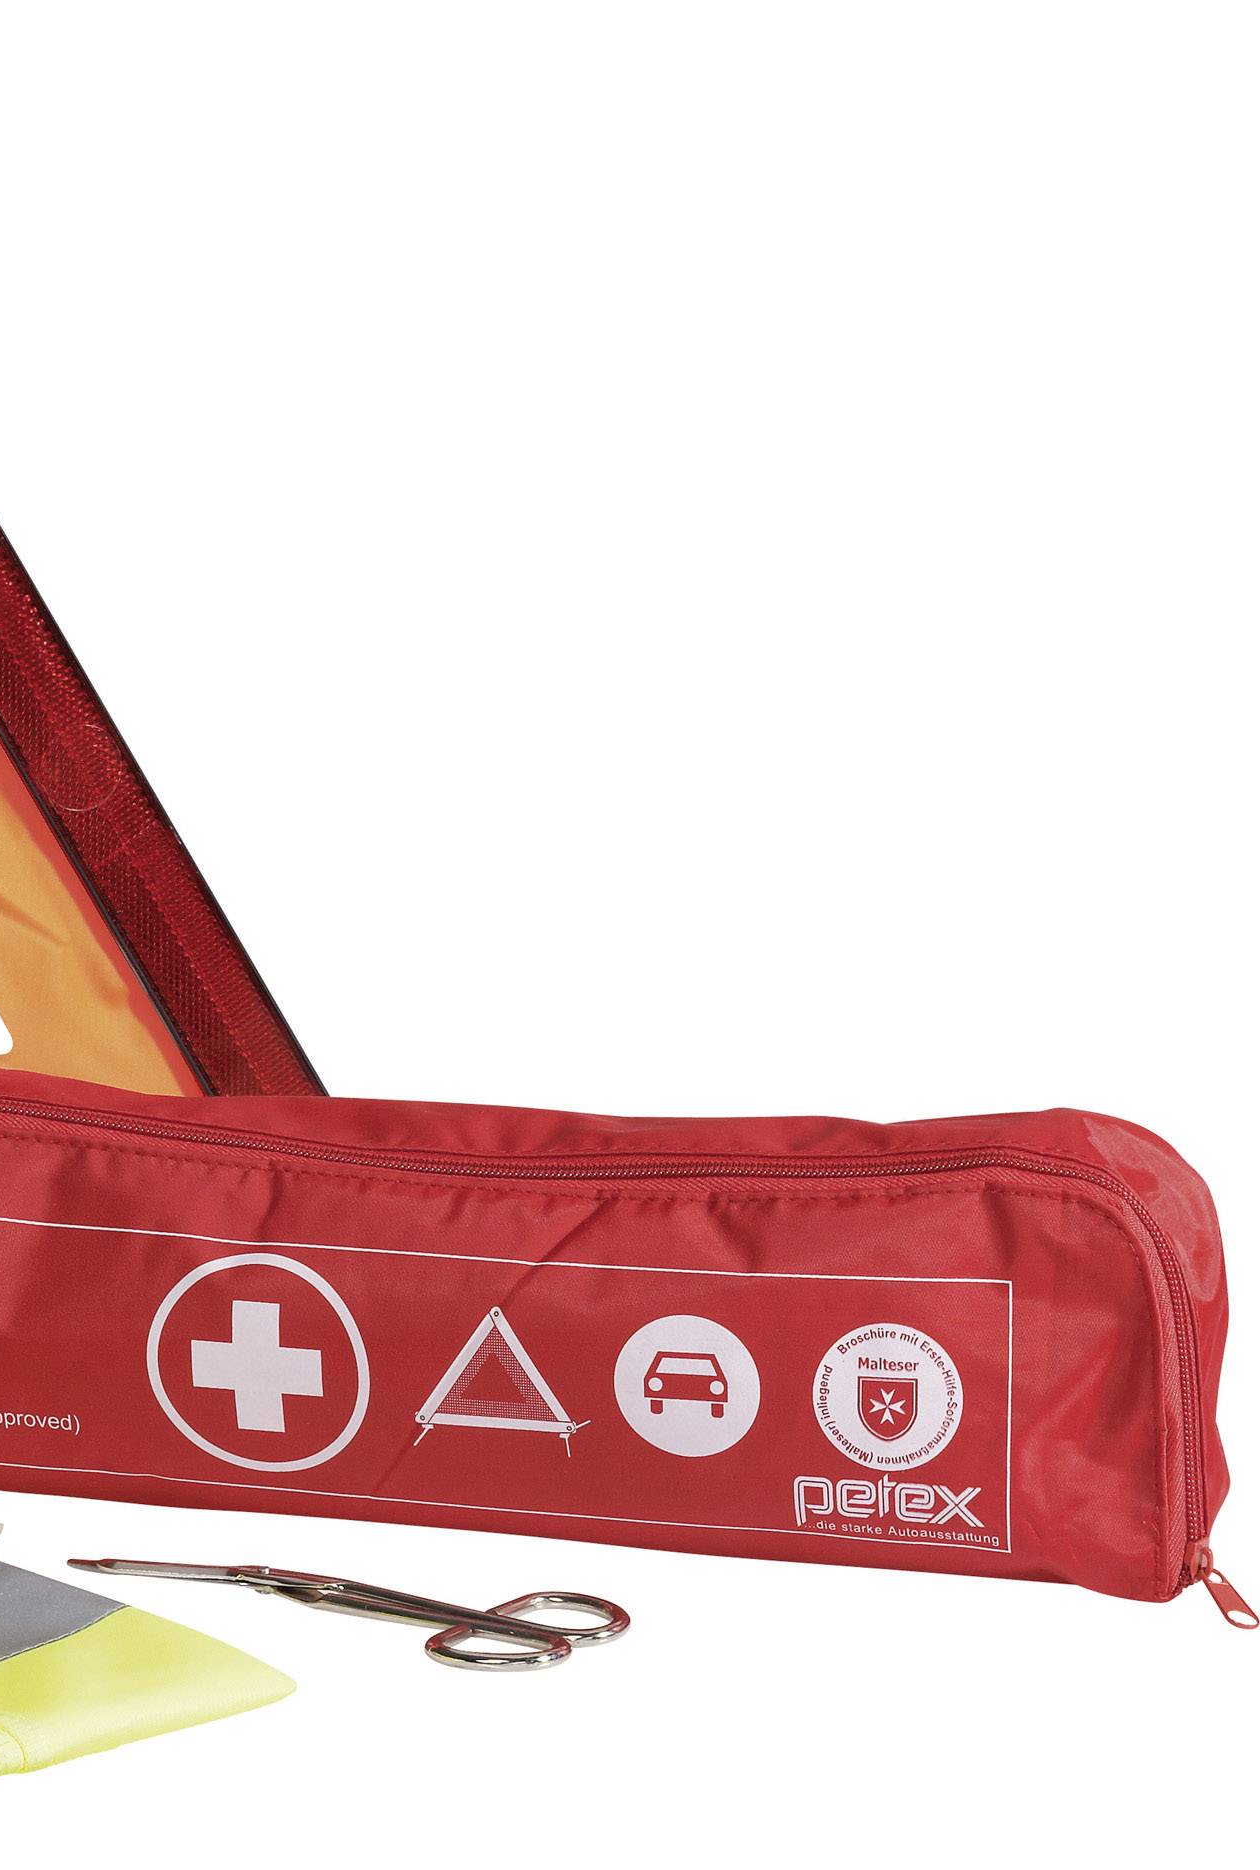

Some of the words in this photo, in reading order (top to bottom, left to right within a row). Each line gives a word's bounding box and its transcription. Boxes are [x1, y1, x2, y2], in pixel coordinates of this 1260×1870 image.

[837, 1327, 897, 1355] Broschüre
[900, 1332, 920, 1345] mit
[857, 1356, 919, 1373] Malteser
[816, 1365, 833, 1421] inliegend
[793, 1473, 986, 1528] petex
[841, 1523, 883, 1535] starke
[888, 1526, 1001, 1547] Autoausstattung
